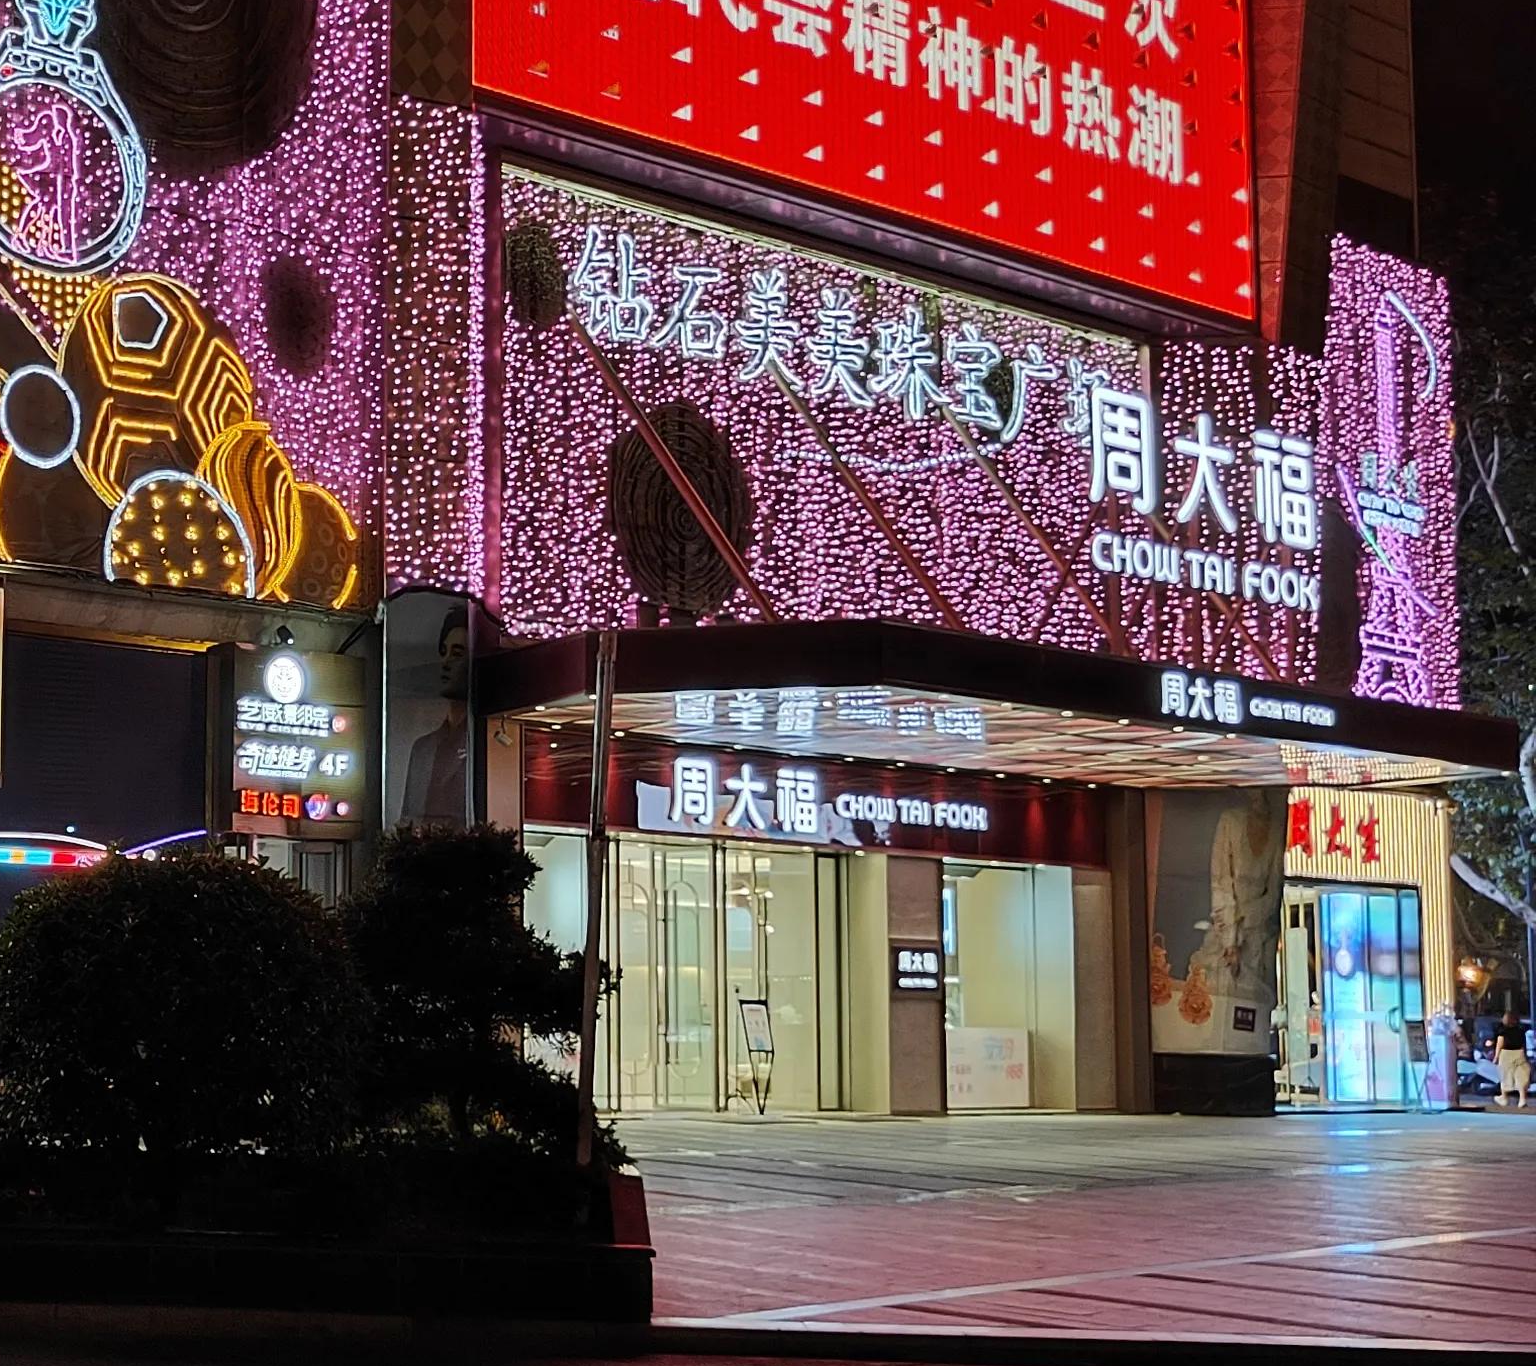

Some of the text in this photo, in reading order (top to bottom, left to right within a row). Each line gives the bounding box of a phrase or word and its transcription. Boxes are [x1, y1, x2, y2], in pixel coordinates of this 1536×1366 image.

[1088, 386, 1319, 551] 周大福
[1090, 531, 1322, 612] CHOW TAI FOOK
[1161, 671, 1244, 725] 周大福
[319, 753, 350, 776] 4F
[241, 789, 300, 818] 海伦司
[671, 756, 820, 834] 周大福
[835, 792, 989, 832] CHOW TAI FOOK
